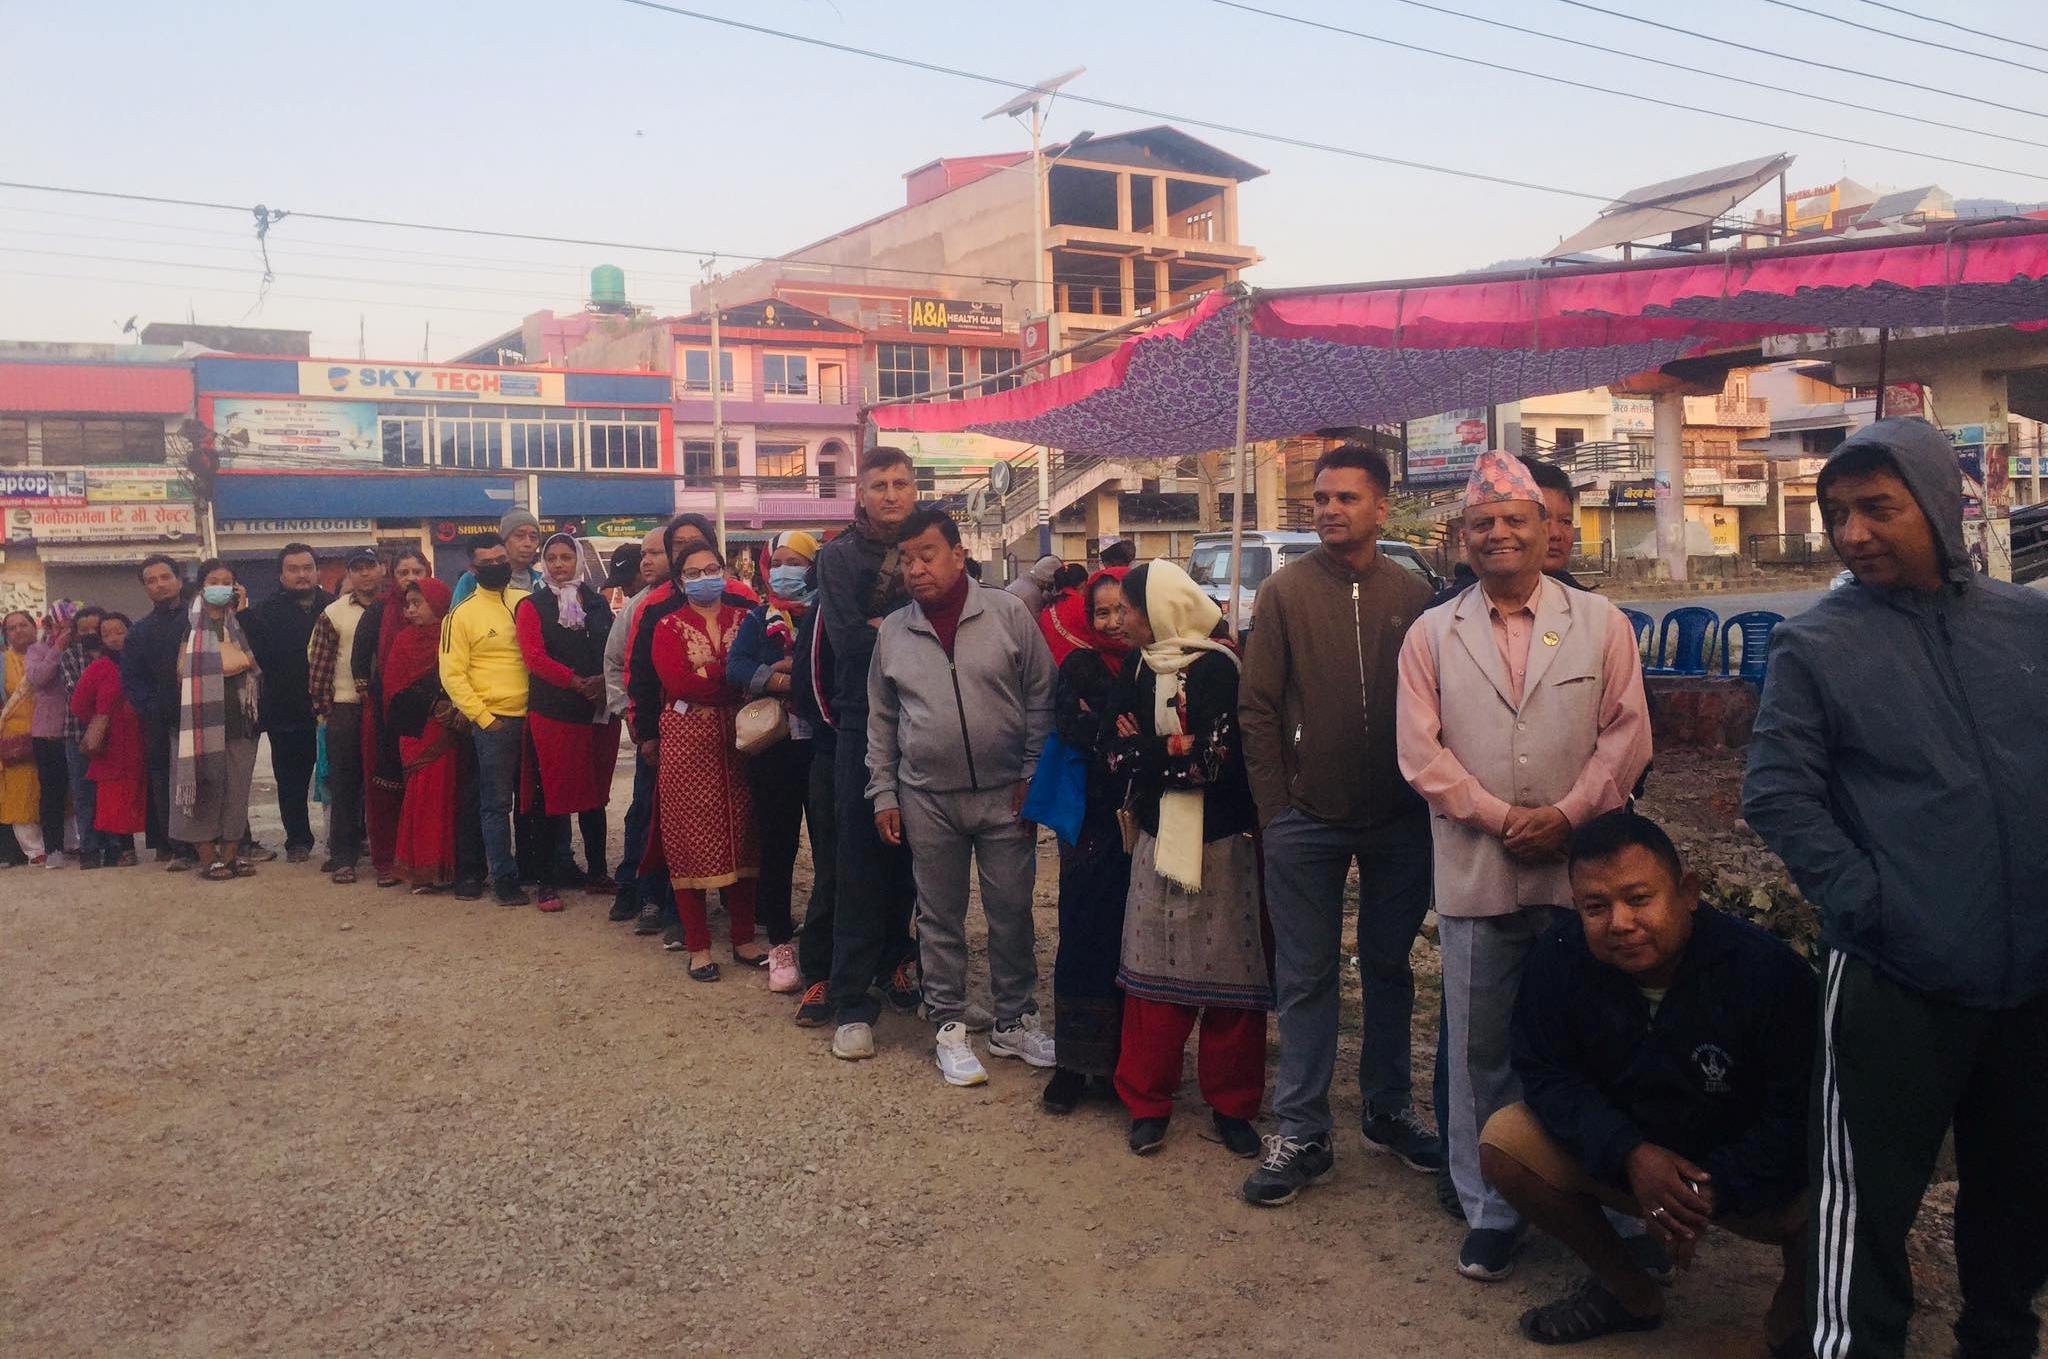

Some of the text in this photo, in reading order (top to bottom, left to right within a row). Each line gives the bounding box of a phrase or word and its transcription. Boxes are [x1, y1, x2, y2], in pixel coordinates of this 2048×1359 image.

[912, 301, 948, 328] A&A
[947, 313, 979, 324] HEALTH
[980, 315, 1002, 325] CLUB
[359, 366, 422, 390] SKY
[432, 372, 499, 392] TECH
[245, 519, 369, 531] TECHNOLOGIES
